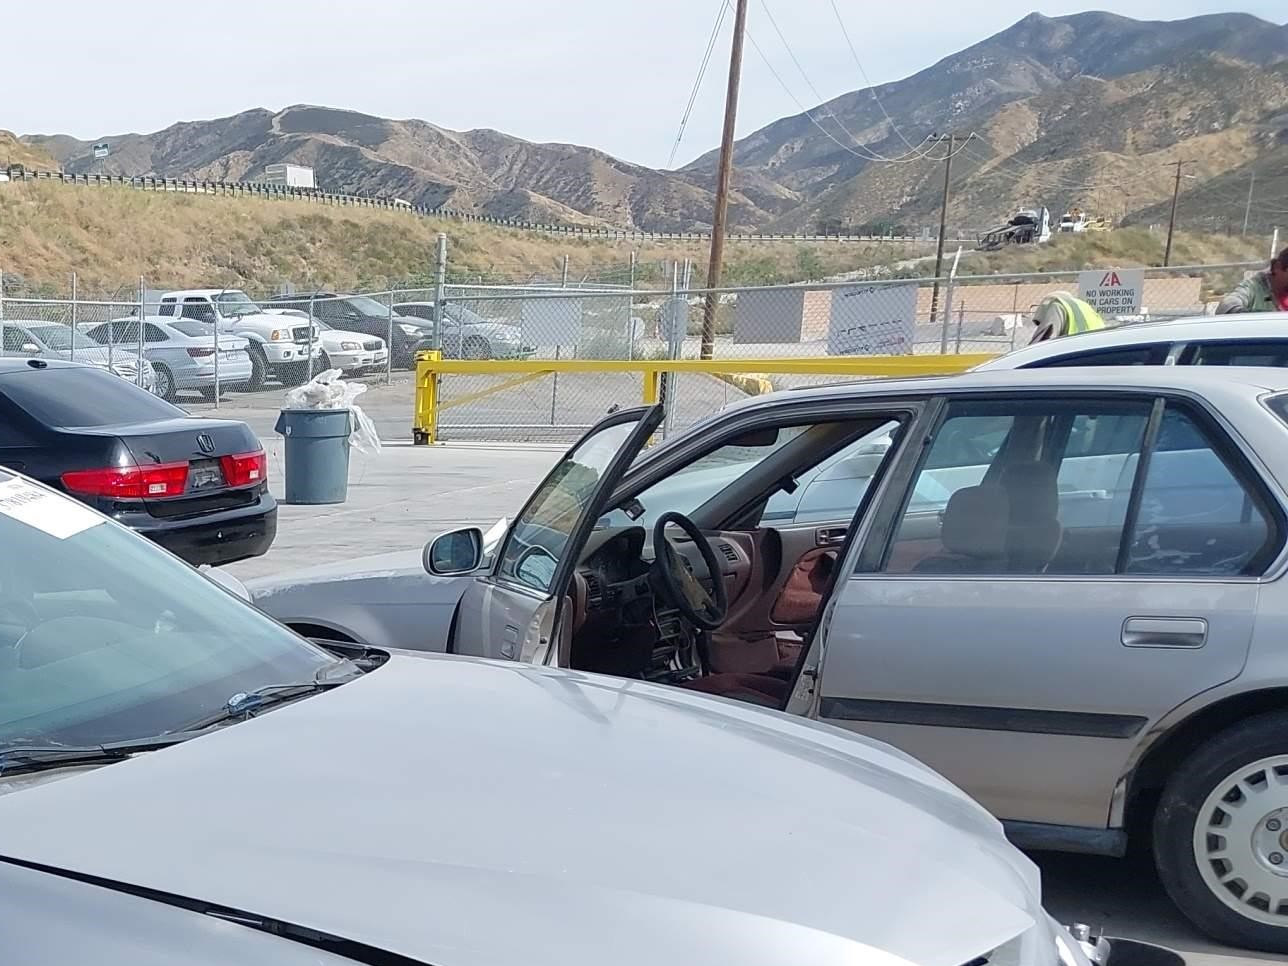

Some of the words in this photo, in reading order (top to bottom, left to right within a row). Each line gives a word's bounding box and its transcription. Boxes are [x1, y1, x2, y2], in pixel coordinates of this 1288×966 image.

[1086, 289, 1097, 297] NO
[1099, 289, 1134, 297] WORKING
[1099, 298, 1119, 306] CARS
[1121, 297, 1133, 305] ON
[1096, 305, 1136, 314] PROPERTY
